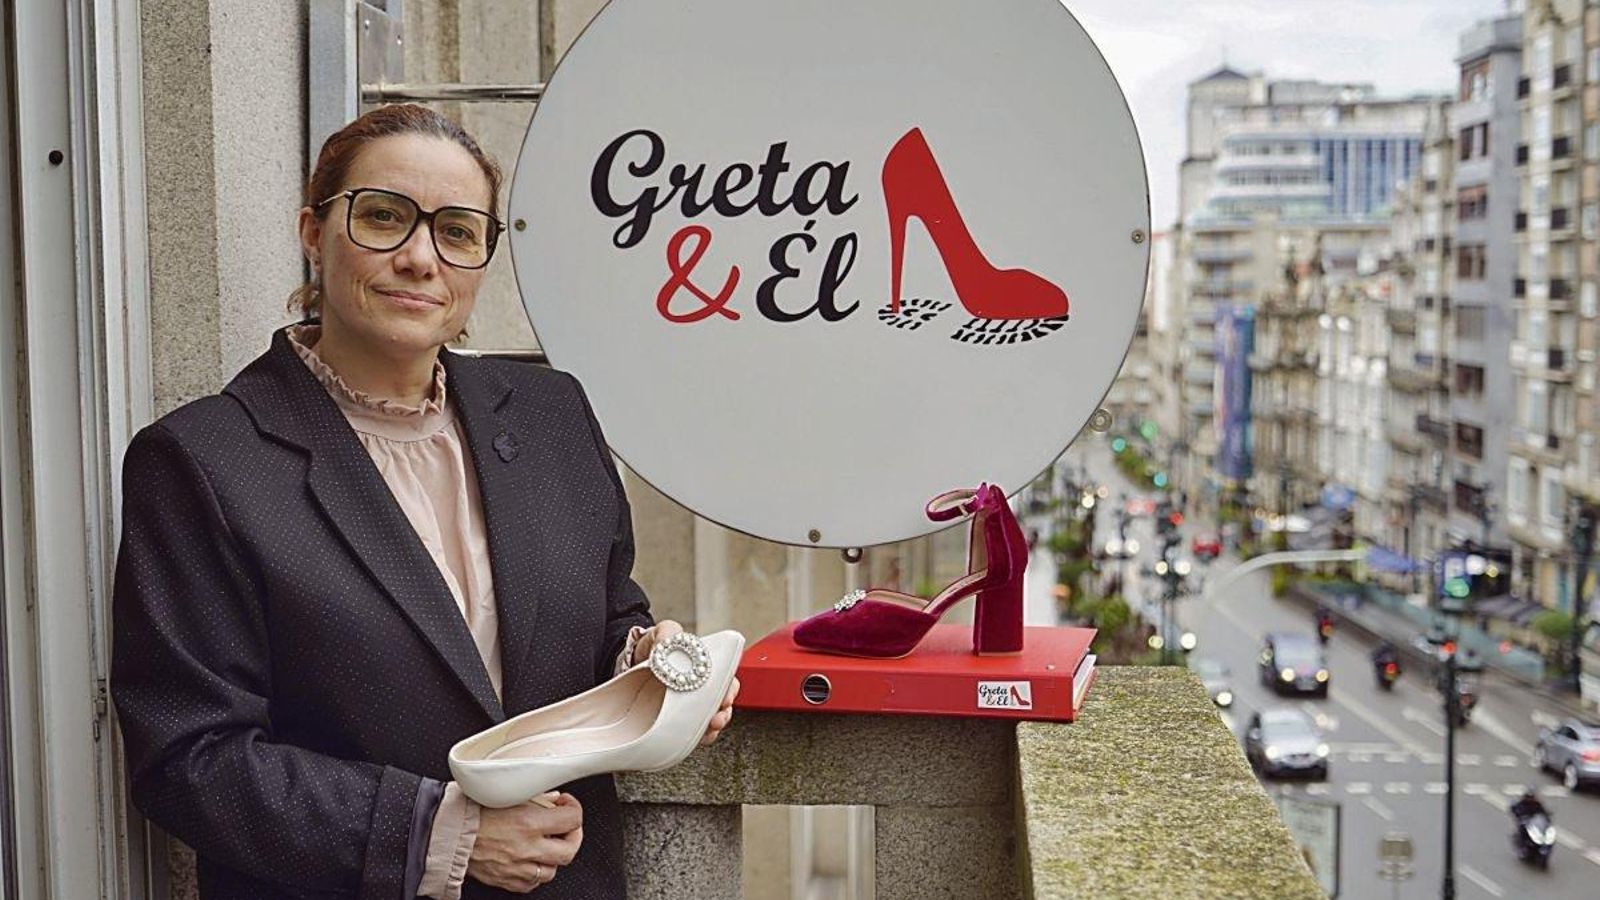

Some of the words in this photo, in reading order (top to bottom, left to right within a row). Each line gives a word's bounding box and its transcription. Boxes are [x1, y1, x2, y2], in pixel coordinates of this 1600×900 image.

[590, 129, 859, 249] Greta
[656, 225, 741, 324] &
[756, 219, 860, 322] Él
[979, 684, 1008, 698] Greta
